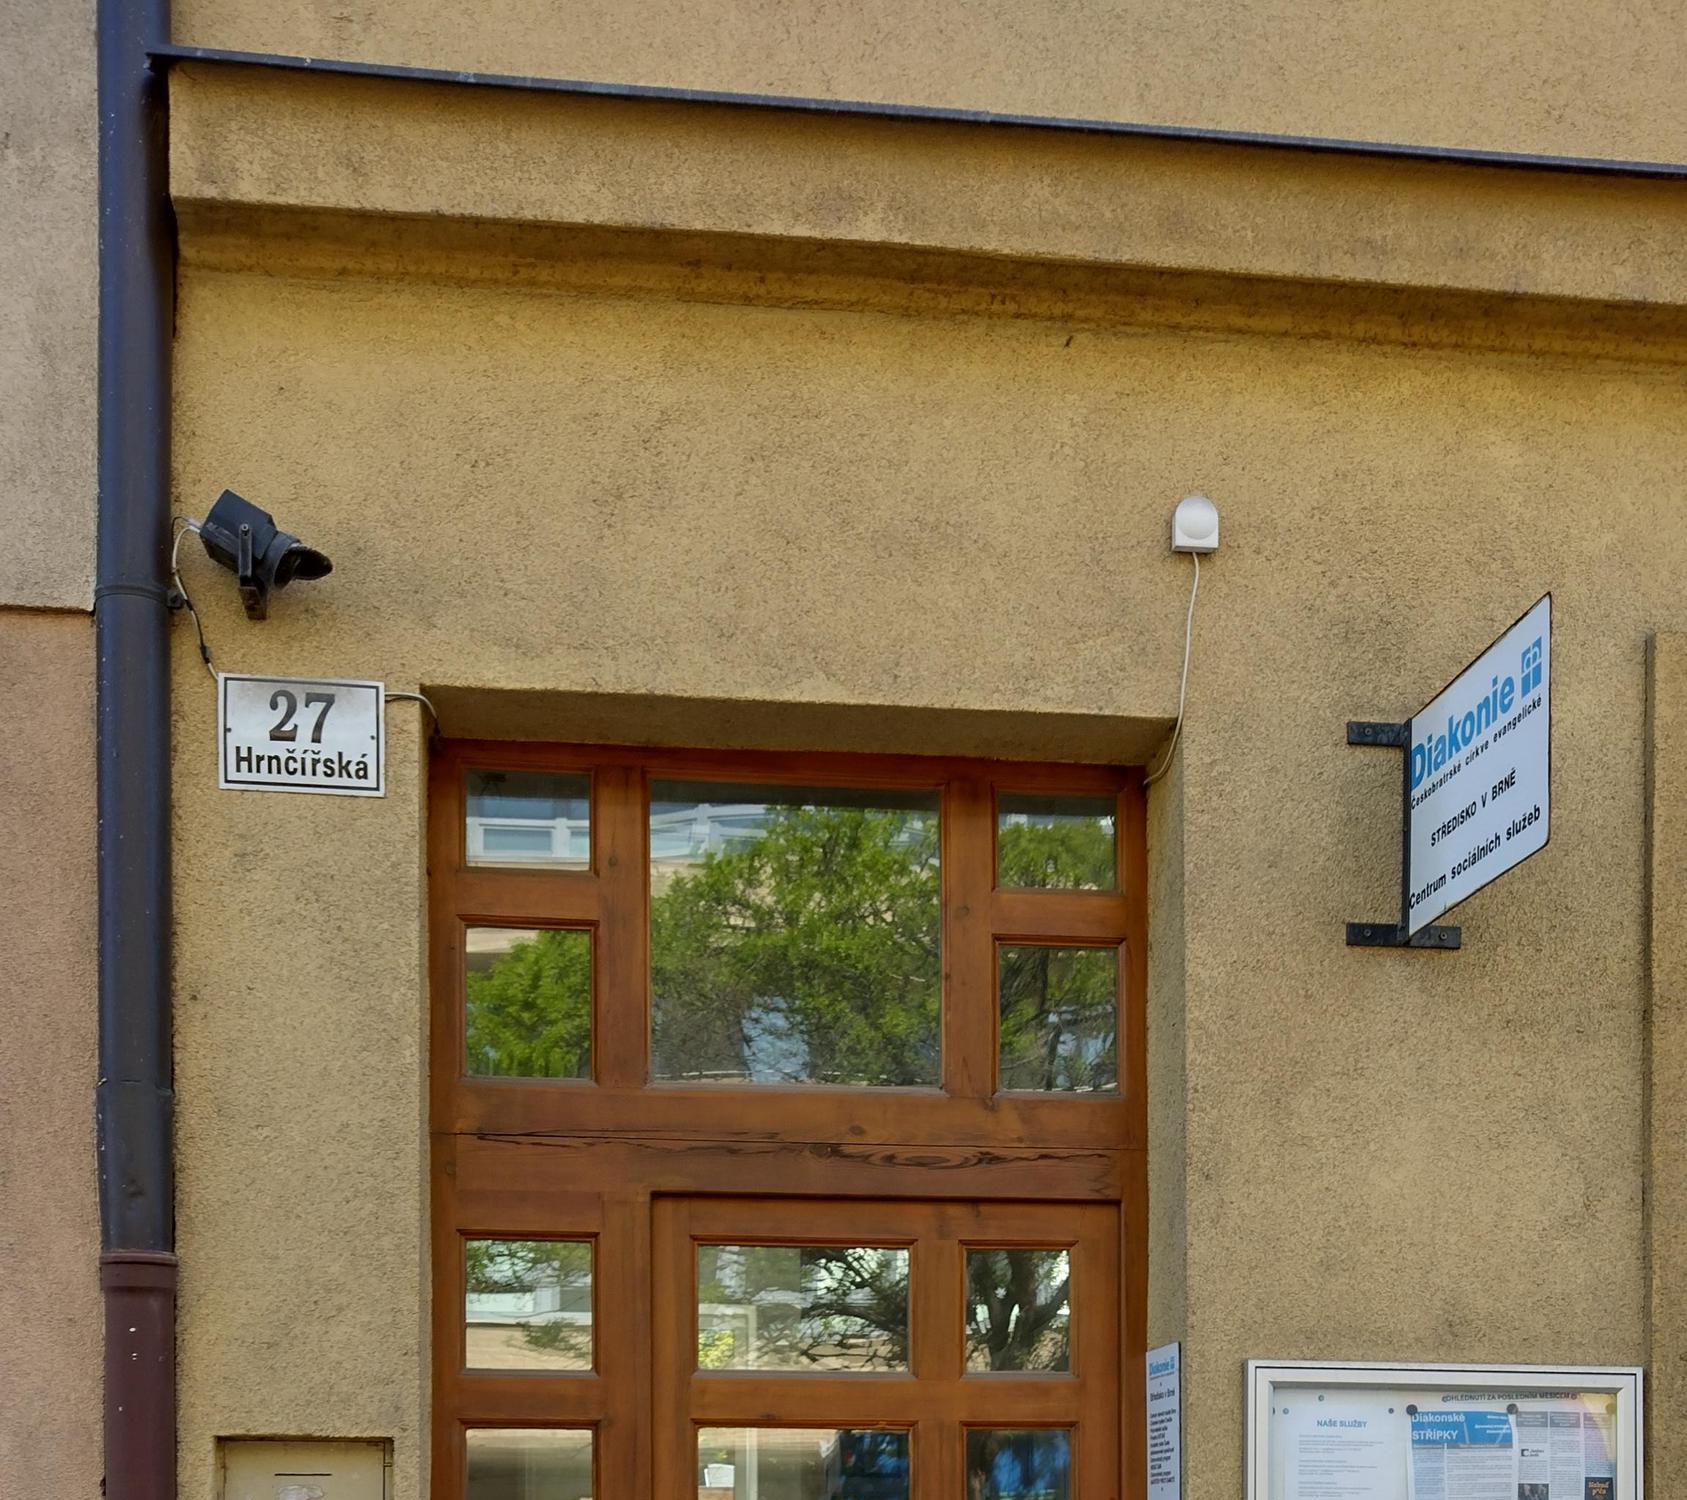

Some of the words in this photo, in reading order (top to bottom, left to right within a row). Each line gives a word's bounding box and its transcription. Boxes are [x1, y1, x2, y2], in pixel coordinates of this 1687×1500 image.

[269, 689, 336, 744] 27
[1411, 675, 1515, 791] Diakonie
[235, 745, 369, 780] Hrnčířská
[1411, 762, 1462, 810] Českobratrské
[1465, 739, 1489, 766] církve
[1493, 693, 1542, 743] evangelické
[1431, 801, 1477, 847] STŘEDISKO
[1481, 792, 1488, 808] V
[1409, 873, 1447, 910] Centrum
[1451, 831, 1501, 880] sociálních
[1506, 804, 1541, 841] služeb
[1317, 1419, 1338, 1428] NAŠE
[1339, 1419, 1368, 1428] SLUŽBY
[1412, 1429, 1458, 1440] STŘÍPKY
